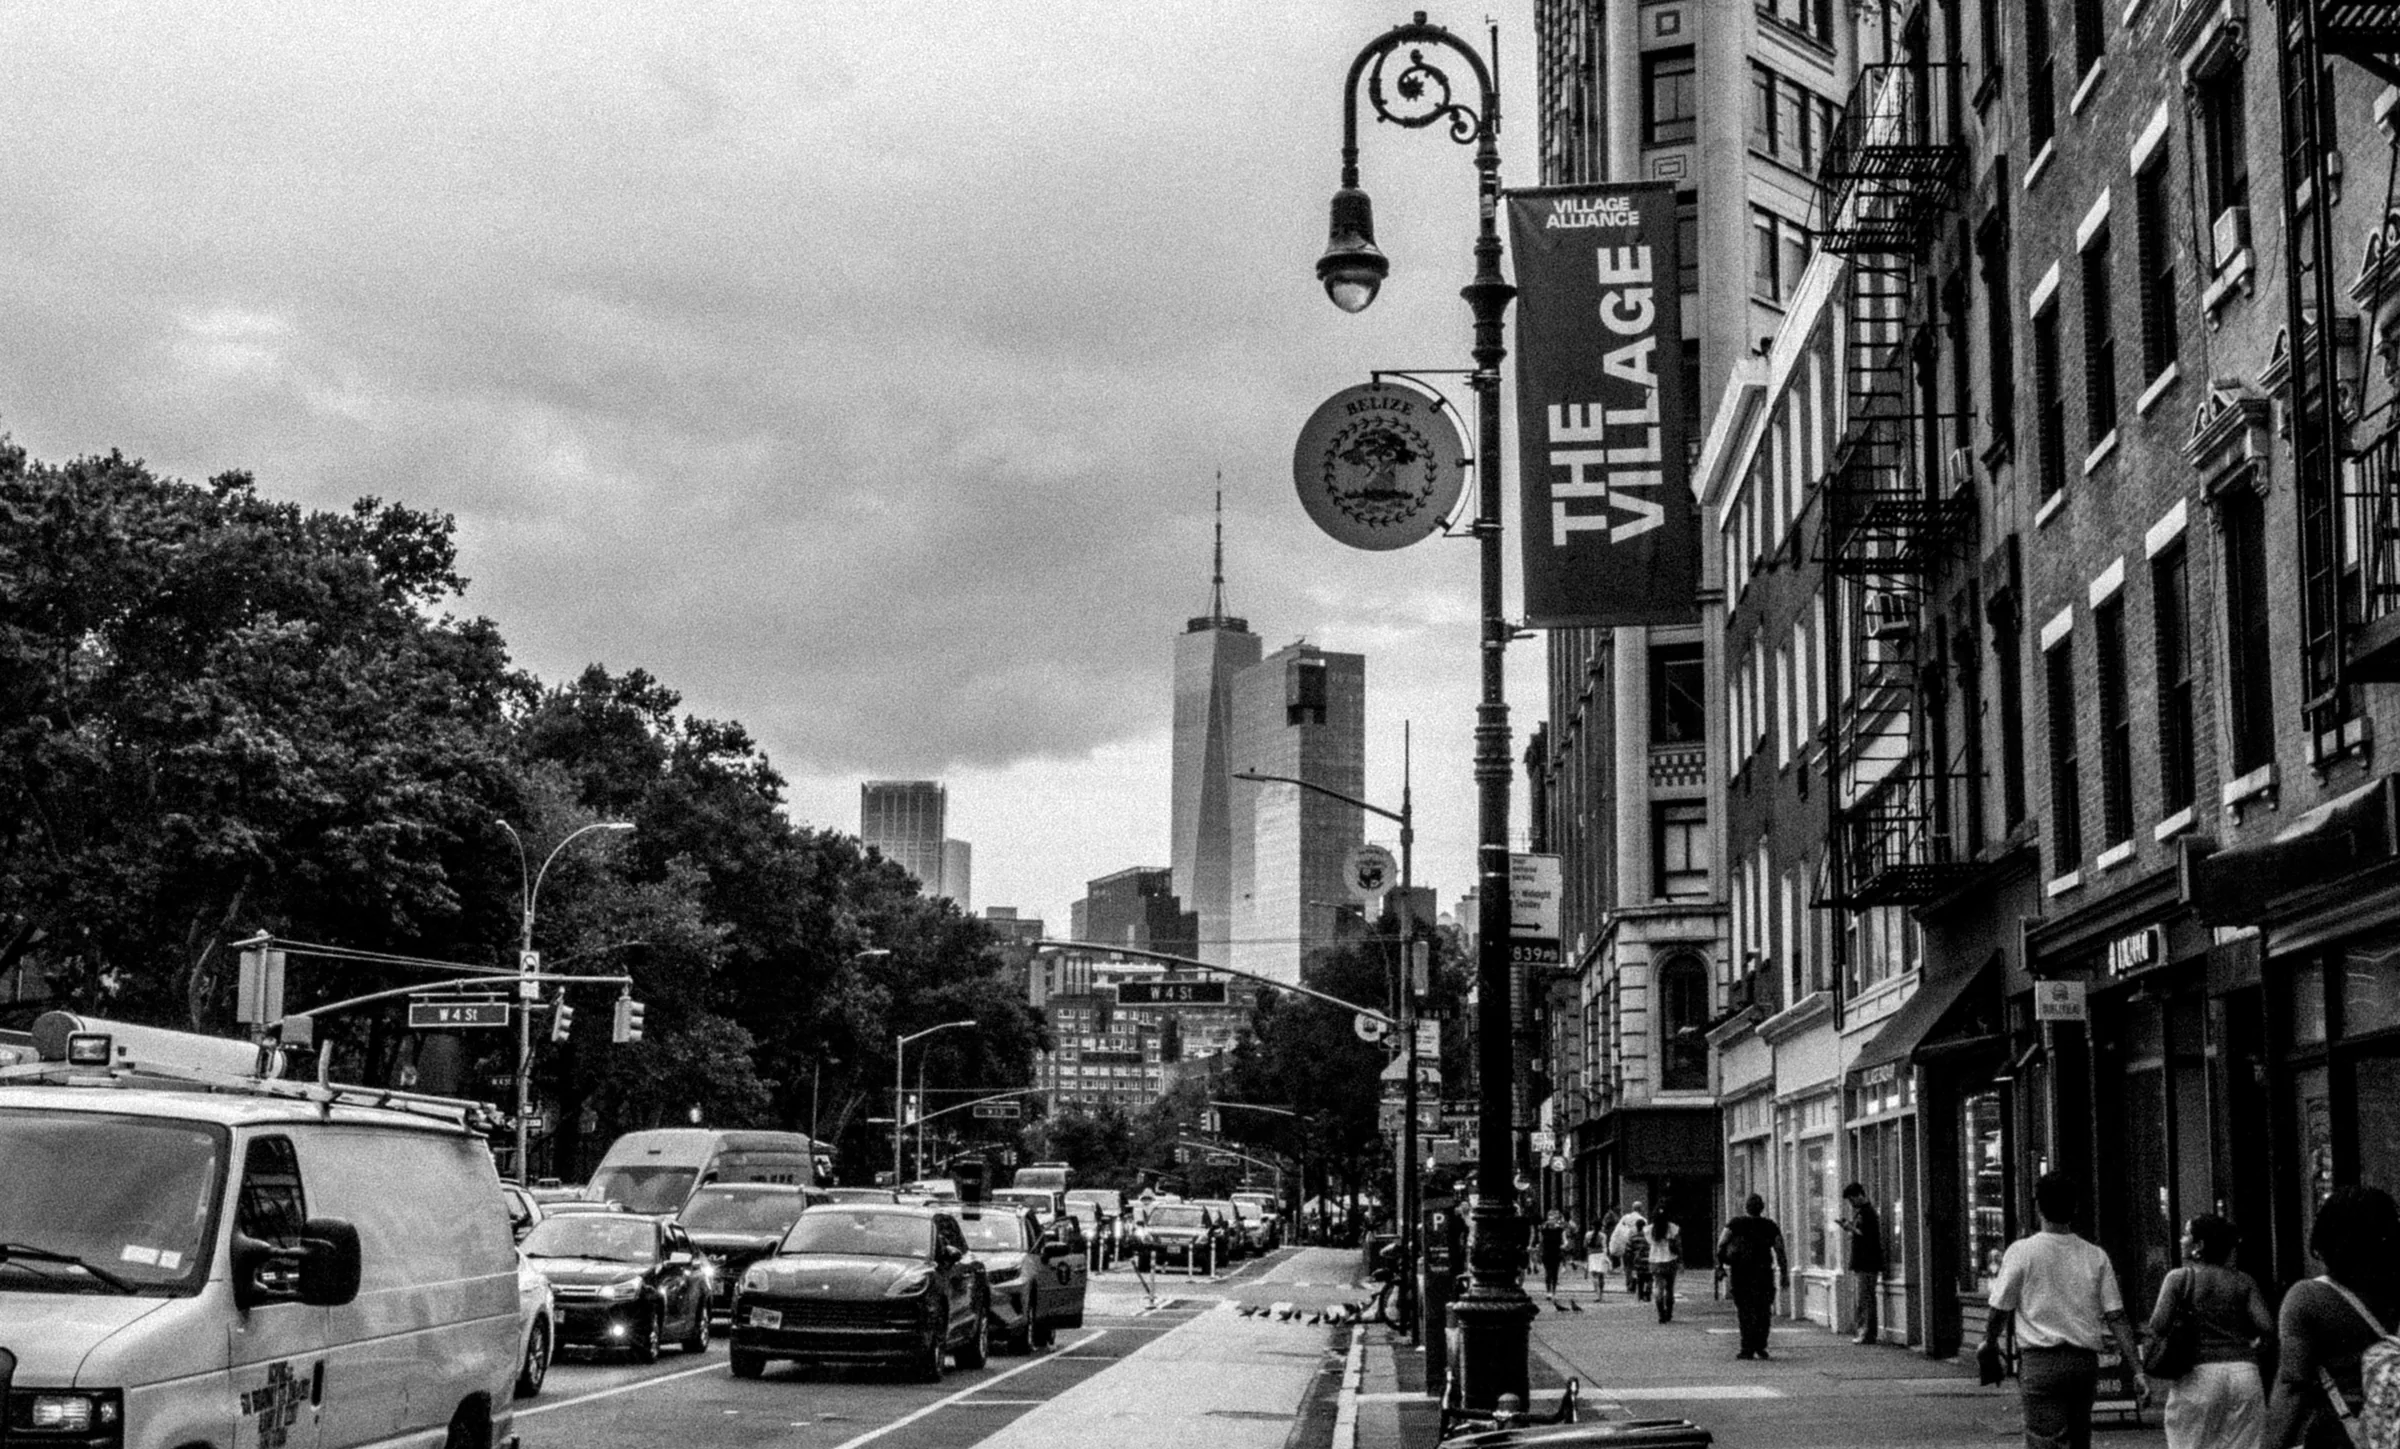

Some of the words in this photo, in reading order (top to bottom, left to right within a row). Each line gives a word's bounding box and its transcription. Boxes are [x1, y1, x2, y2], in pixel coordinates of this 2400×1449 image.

[1552, 197, 1630, 213] VILLAGE
[1546, 211, 1639, 228] ALLIANCE
[1597, 244, 1665, 544] VILLAGE
[1346, 397, 1414, 415] BELIZE
[1547, 402, 1608, 546] THE
[1522, 890, 1551, 899] Midnight
[1151, 986, 1160, 999] W
[1165, 986, 1174, 999] 4
[1180, 986, 1192, 1000] St
[440, 1009, 449, 1021] W
[452, 1008, 460, 1021] 4
[465, 1008, 478, 1021] St
[1433, 1213, 1445, 1231] P
